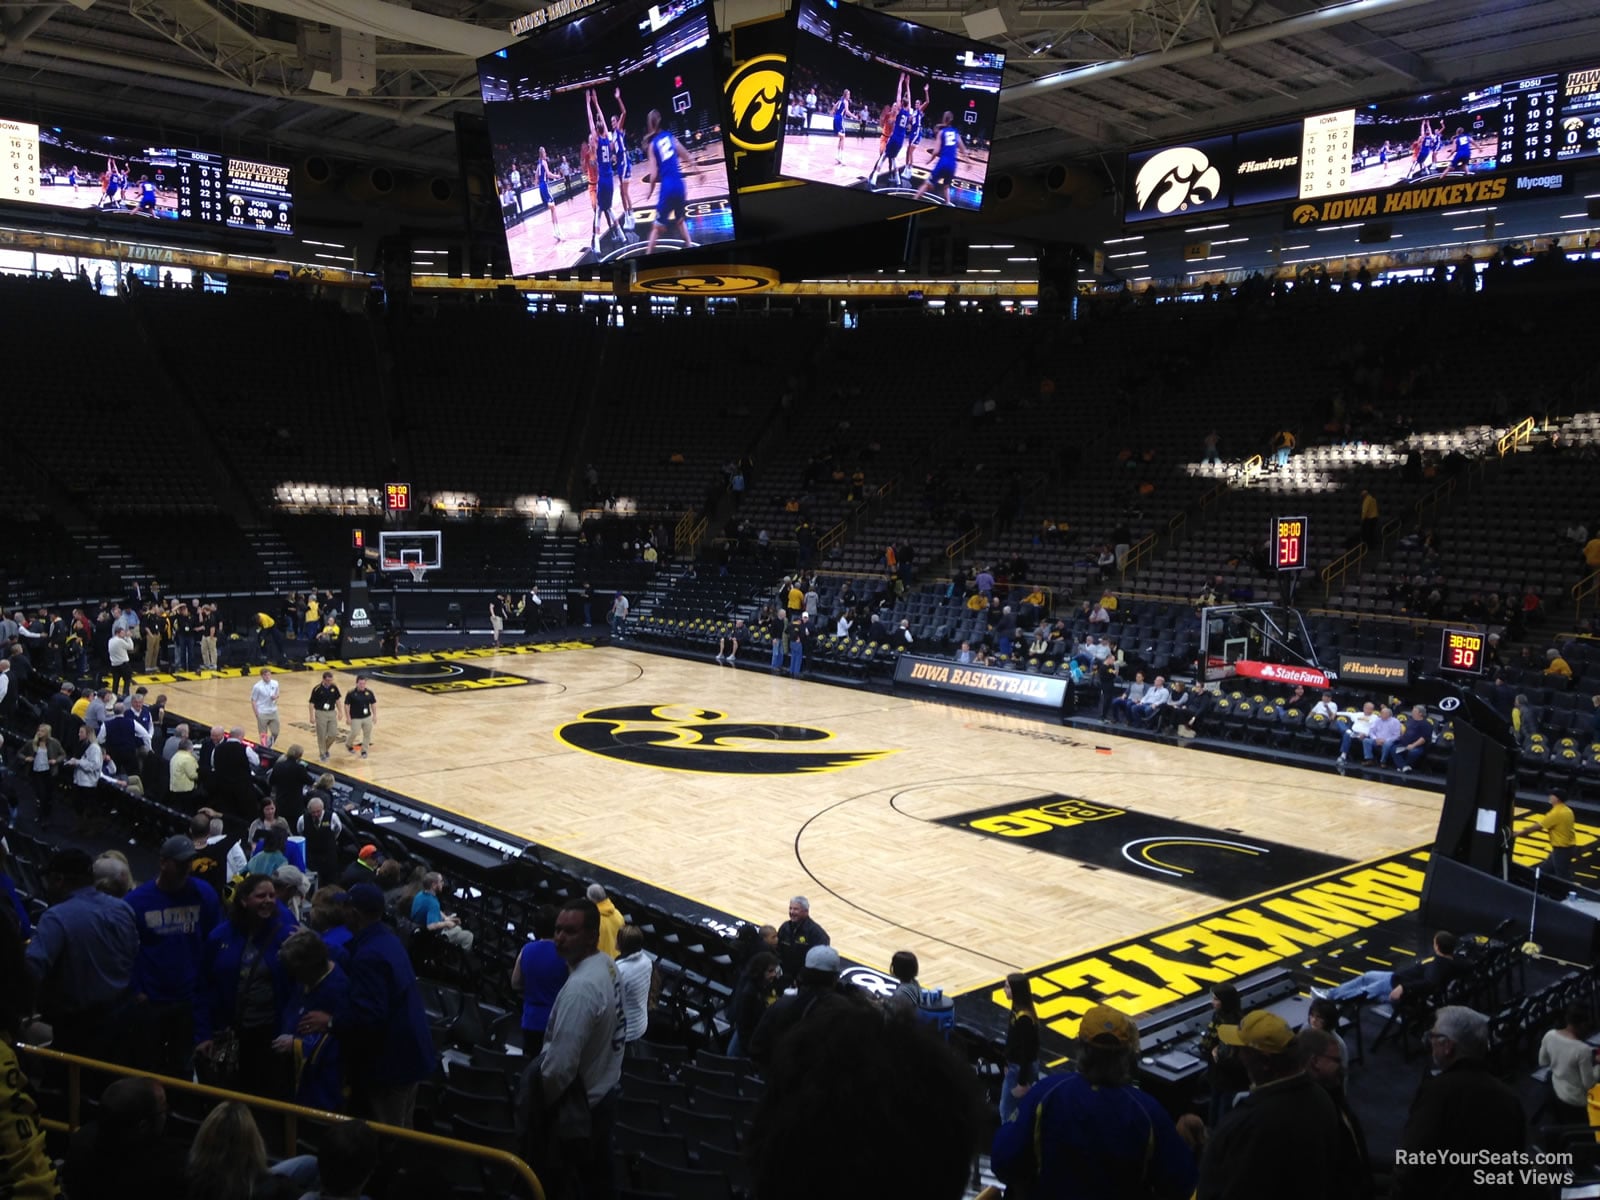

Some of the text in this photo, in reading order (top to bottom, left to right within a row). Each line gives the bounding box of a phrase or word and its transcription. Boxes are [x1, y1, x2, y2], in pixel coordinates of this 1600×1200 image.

[1519, 79, 1541, 89] SDSU
[1507, 94, 1554, 110] 1 0 3
[1504, 107, 1554, 123] 11 10 0
[1503, 120, 1553, 135] 12 22 3
[11, 140, 33, 150] 16 2
[1501, 135, 1552, 150] 21 15 3
[1567, 131, 1578, 144] 0
[657, 136, 675, 161] 2
[1326, 144, 1336, 152] 21
[1500, 148, 1551, 163] 45 11 3
[10, 151, 34, 161] 21 0
[182, 166, 187, 174] 1
[214, 171, 221, 179] 3
[228, 159, 290, 179] HAWKEYES
[1238, 156, 1298, 174] #Hawkeyes
[181, 176, 221, 189] 11 10 0
[228, 170, 288, 185] HOME EVENTS
[1517, 174, 1563, 190] Mycogen
[181, 186, 221, 199] 12 22 3
[1320, 178, 1507, 221] IOWA HAWKEYES
[181, 198, 221, 210] 21 15 3
[233, 205, 241, 216] 0
[201, 211, 210, 220] 11
[215, 213, 222, 221] 3
[248, 207, 273, 219] 38:00
[279, 212, 288, 223] 0
[129, 245, 173, 262] IOWA
[387, 486, 407, 495] 38:00
[390, 494, 405, 508] 30
[1279, 522, 1301, 537] 38:00
[1280, 538, 1298, 563] 30
[1450, 635, 1481, 651] 38:00
[1454, 649, 1474, 666] 30
[1343, 661, 1405, 678] #Hawkeyes
[911, 663, 1049, 698] IOWA BASKETBALL
